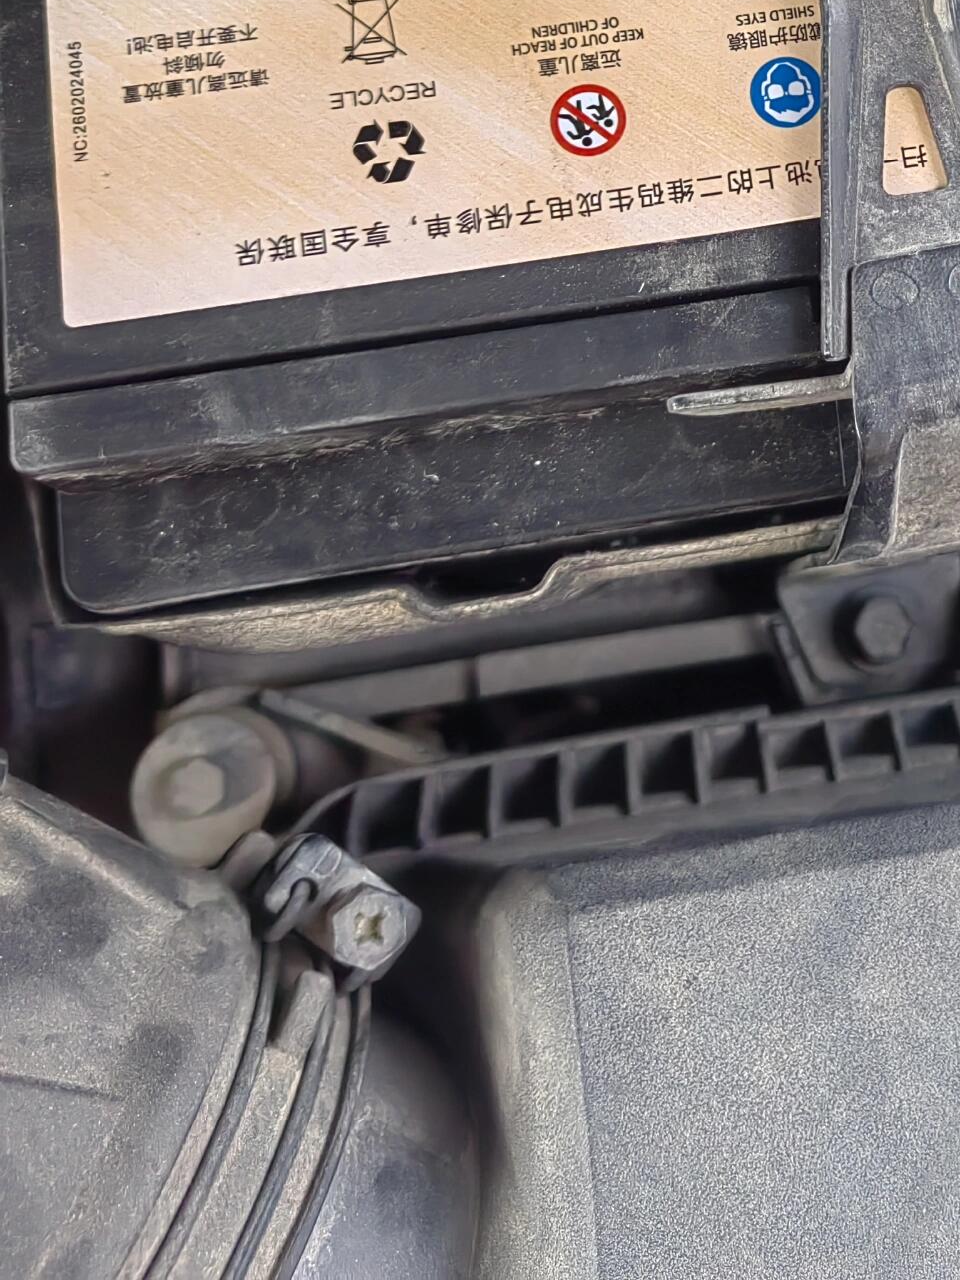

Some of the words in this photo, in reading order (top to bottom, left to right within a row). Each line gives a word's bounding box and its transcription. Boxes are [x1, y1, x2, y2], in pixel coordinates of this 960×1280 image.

[736, 12, 765, 26] EYES
[770, 5, 814, 21] SHIELD
[532, 19, 598, 38] CHILDREN
[601, 17, 619, 29] OF
[559, 37, 578, 49] OF
[581, 33, 608, 47] OUT
[612, 28, 644, 42] KEEP
[511, 40, 555, 56] REACH
[162, 51, 225, 75] 勿倾斜
[538, 49, 621, 77] 远离儿童
[121, 68, 269, 103] 请远离儿童放置
[67, 40, 89, 163] NC:2602024045
[329, 81, 436, 110] RECYCLE
